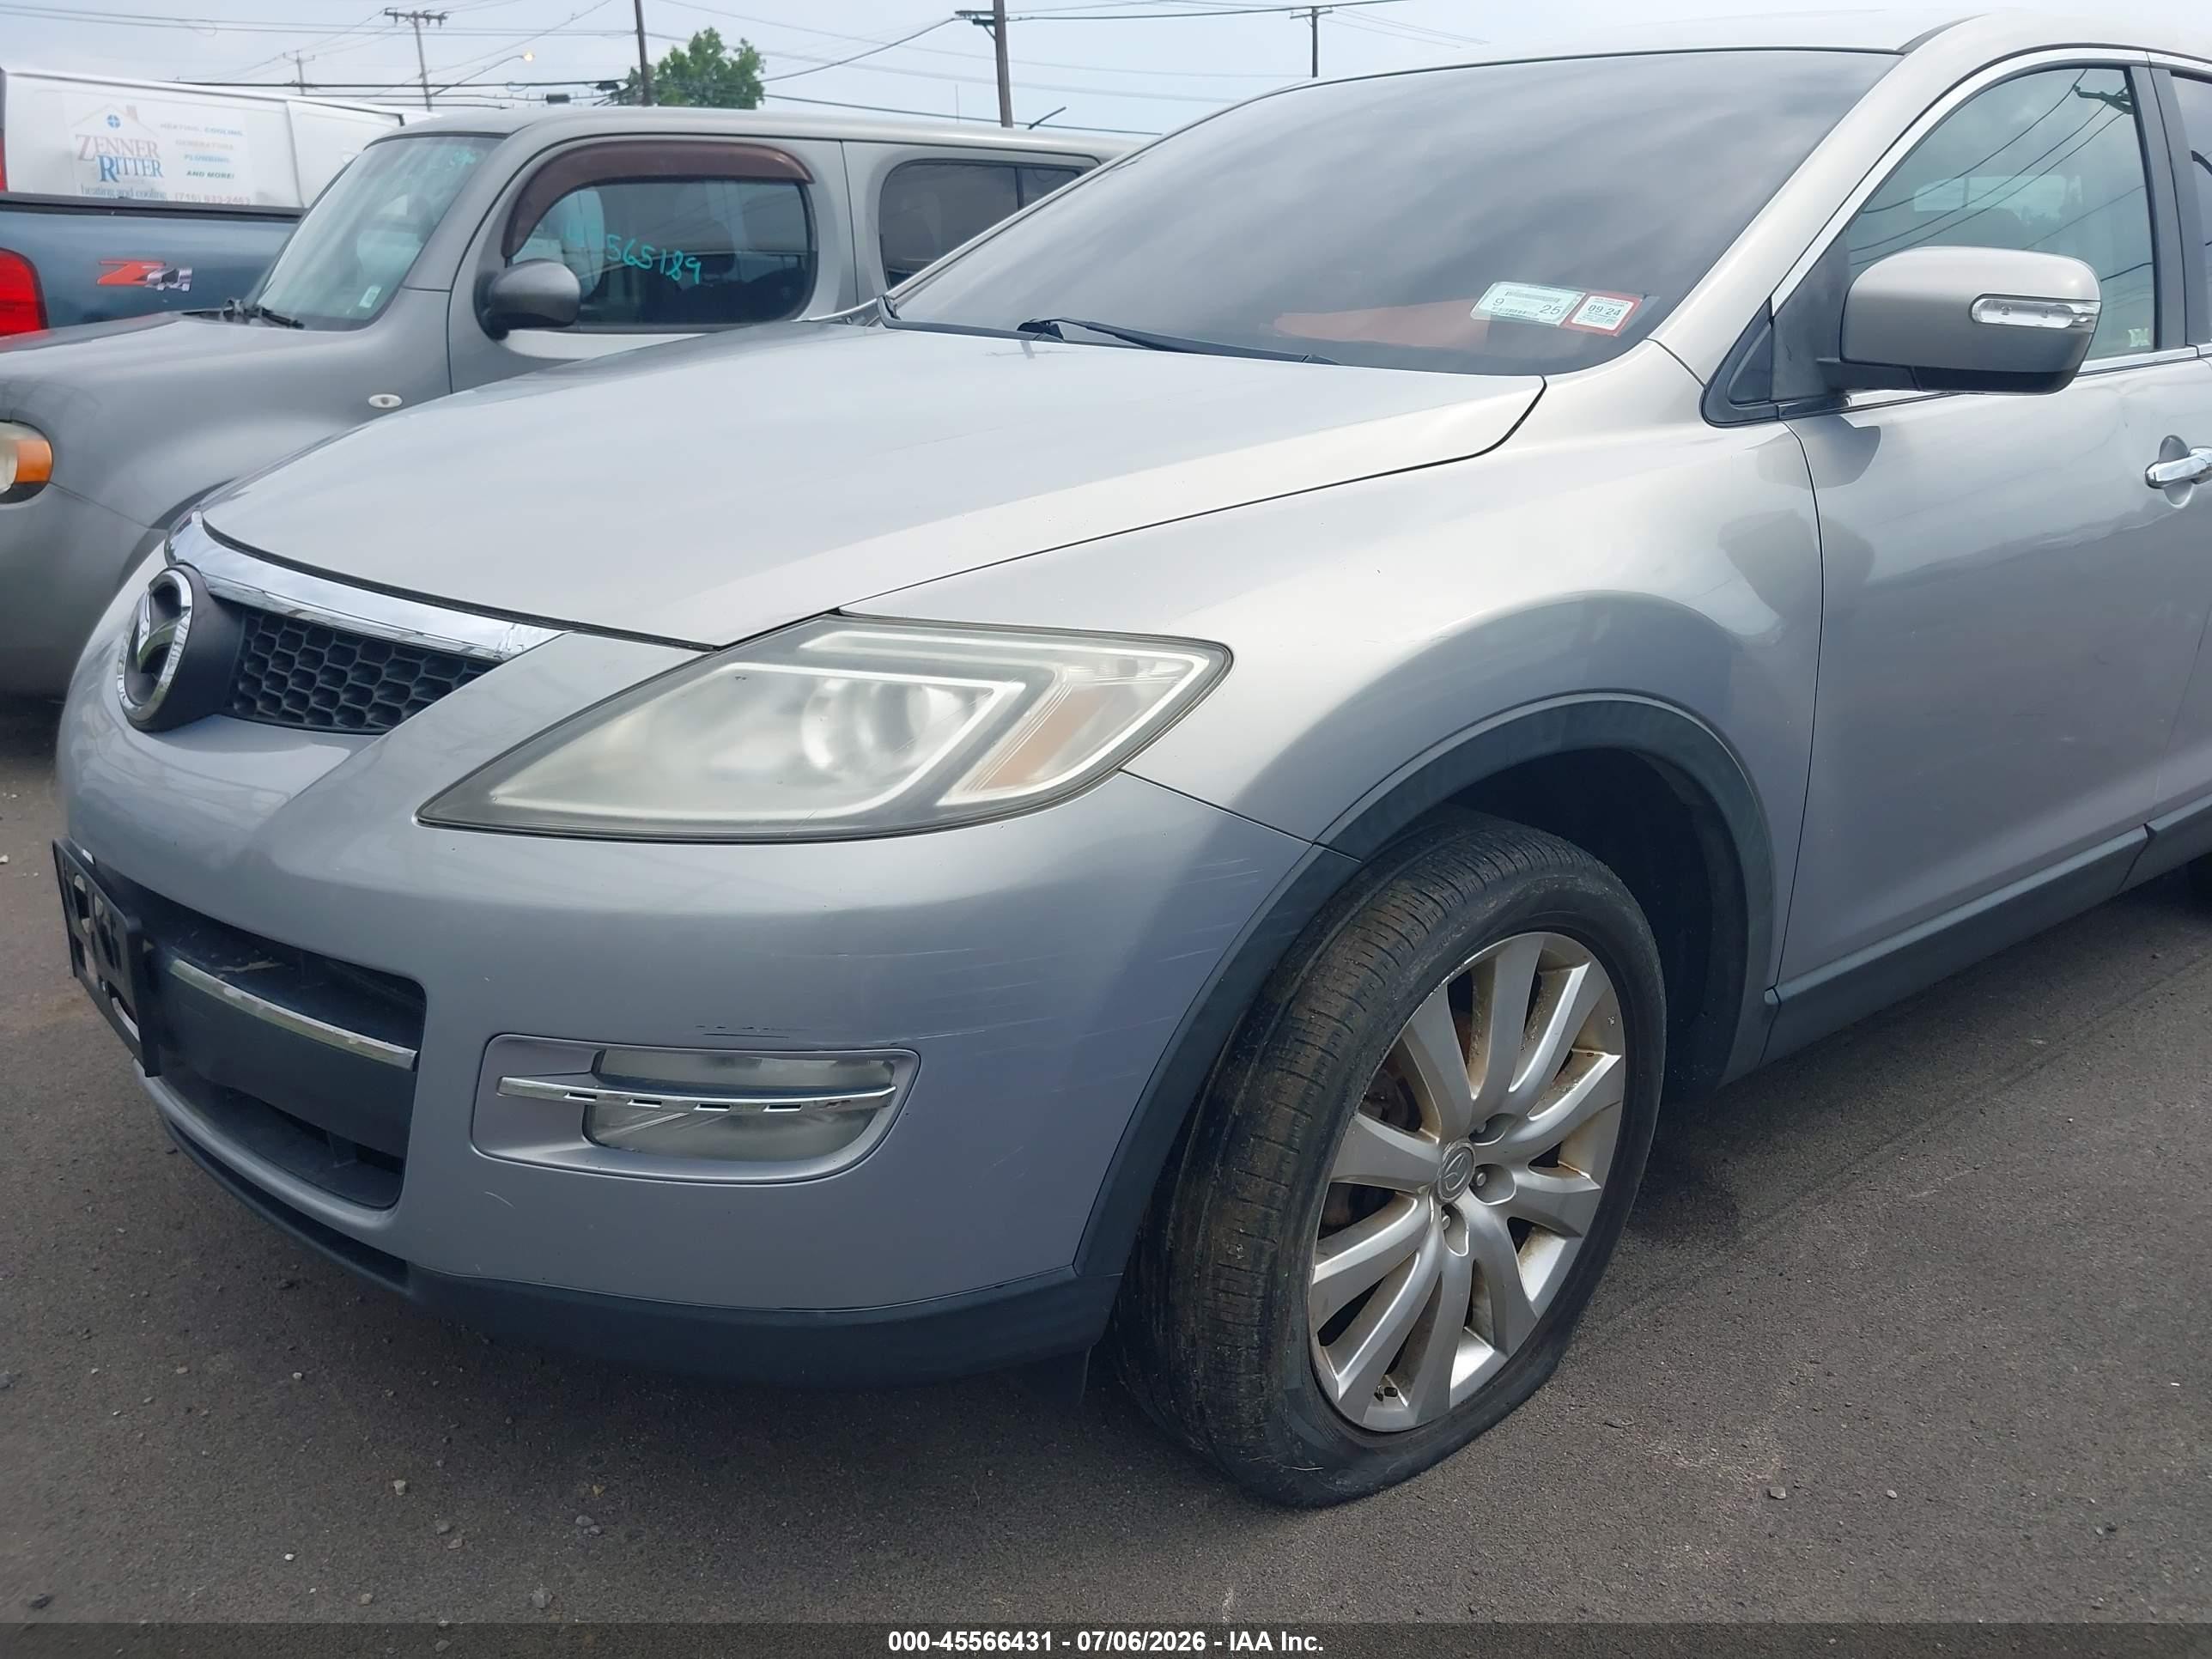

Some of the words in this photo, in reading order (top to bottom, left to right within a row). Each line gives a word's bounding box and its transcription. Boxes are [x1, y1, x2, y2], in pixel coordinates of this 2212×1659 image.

[75, 134, 161, 161] ZENNER
[97, 155, 165, 183] RITTER
[80, 183, 115, 198] heating
[1492, 297, 1505, 307] 9
[1538, 304, 1563, 315] 25
[1587, 304, 1604, 313] 09
[1605, 307, 1622, 316] 24
